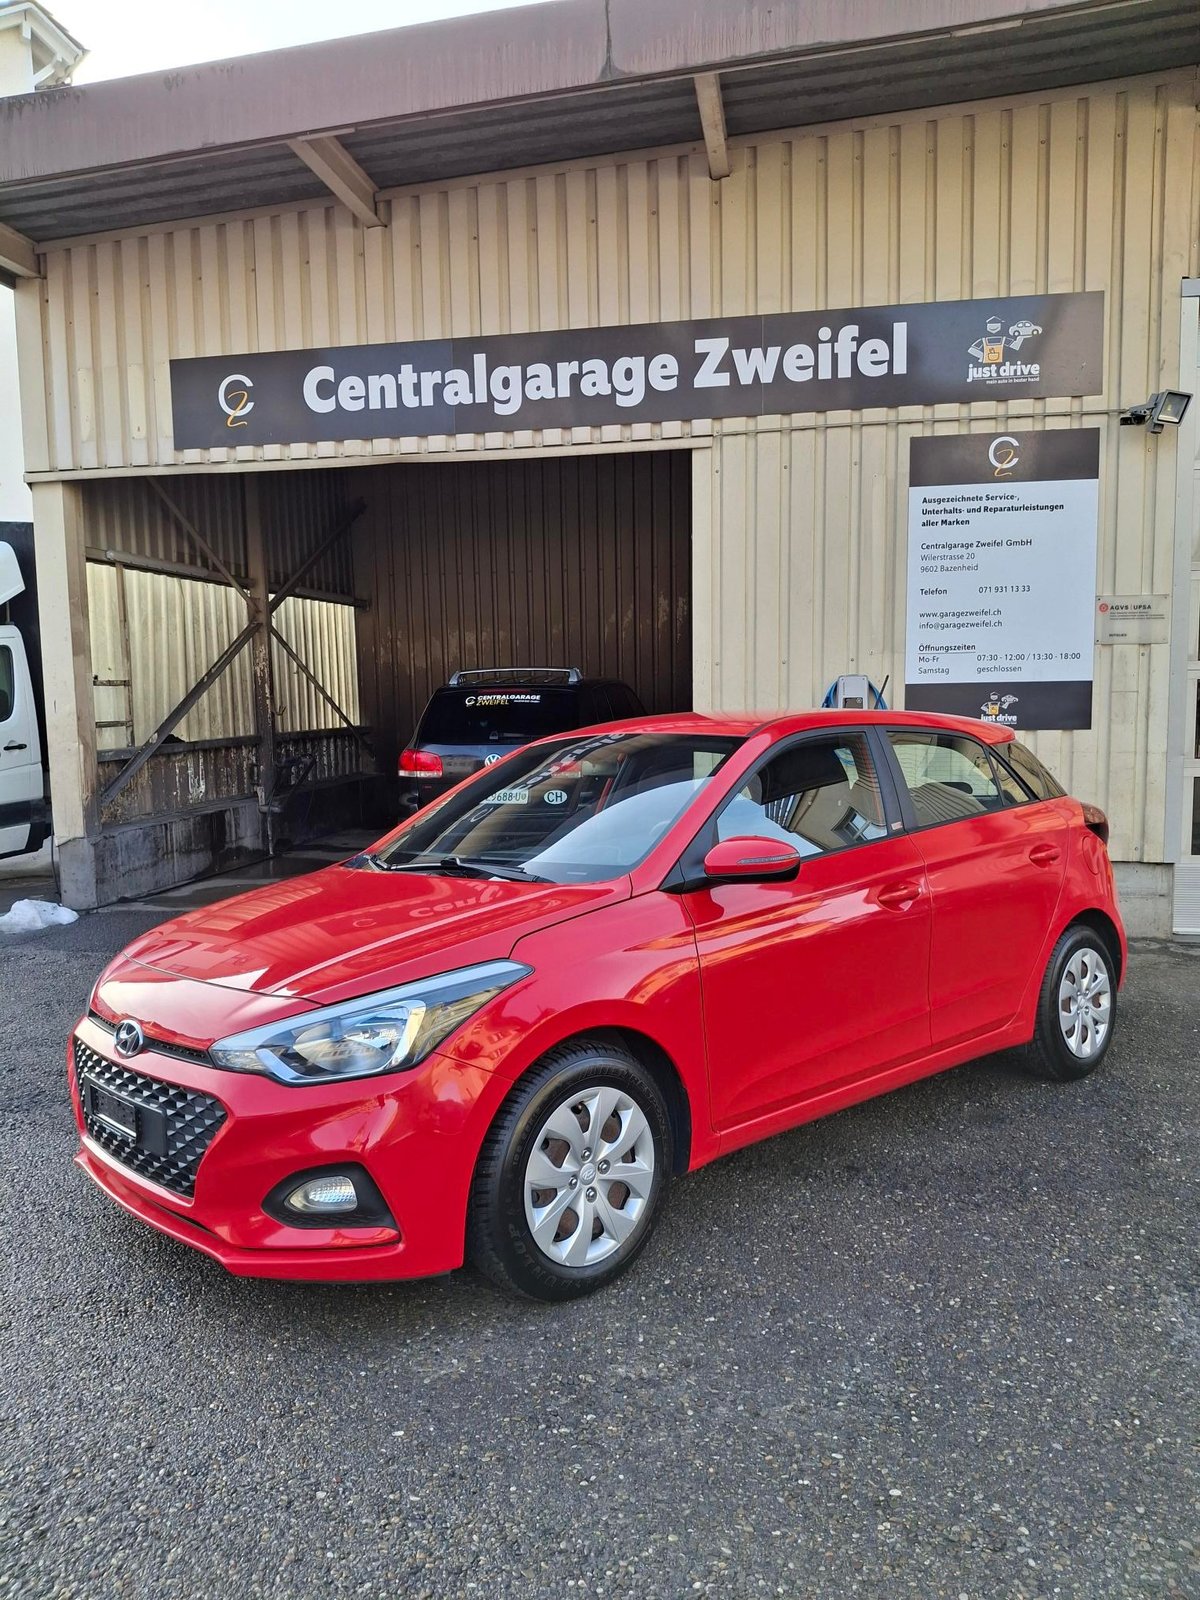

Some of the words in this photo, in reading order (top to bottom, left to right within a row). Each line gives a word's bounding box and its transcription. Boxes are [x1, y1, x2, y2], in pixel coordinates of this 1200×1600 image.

[302, 352, 679, 415] Centralgarage
[693, 321, 908, 389] Zweifel
[967, 363, 997, 382] just
[1000, 361, 1040, 377] drive
[922, 494, 984, 505] Ausgezeichnete
[921, 507, 965, 516] Unterhalts-
[966, 505, 982, 514] und
[983, 503, 1065, 514] Reparaturleistungen
[921, 519, 939, 527] aller
[940, 518, 970, 526] Marken
[920, 540, 974, 551] Centralgarage
[975, 539, 1004, 548] Zweifel
[1005, 538, 1033, 547] GmbH
[920, 553, 965, 562] Wilerstrasse
[965, 552, 976, 560] 20
[920, 565, 938, 573] 9602
[940, 563, 979, 572] Bazenheid
[920, 588, 948, 596] Telefon
[978, 585, 992, 594] 071
[994, 585, 1008, 593] 931
[1010, 585, 1020, 593] 13
[1021, 584, 1031, 592] 33
[919, 609, 1002, 619] www.garagezweifel.ch
[918, 620, 1003, 631] info@garagezweifel.ch
[918, 643, 976, 653] Öffnungszeiten
[918, 655, 940, 664] Mo-Fr
[976, 653, 998, 662] 07:30
[1004, 653, 1026, 661] 12:00
[1032, 652, 1054, 661] 13:30
[1059, 652, 1081, 660] 18:00
[918, 667, 950, 675] Samstag
[976, 665, 1022, 674] geschlossen
[997, 713, 1018, 722] drive
[547, 791, 563, 803] CH
